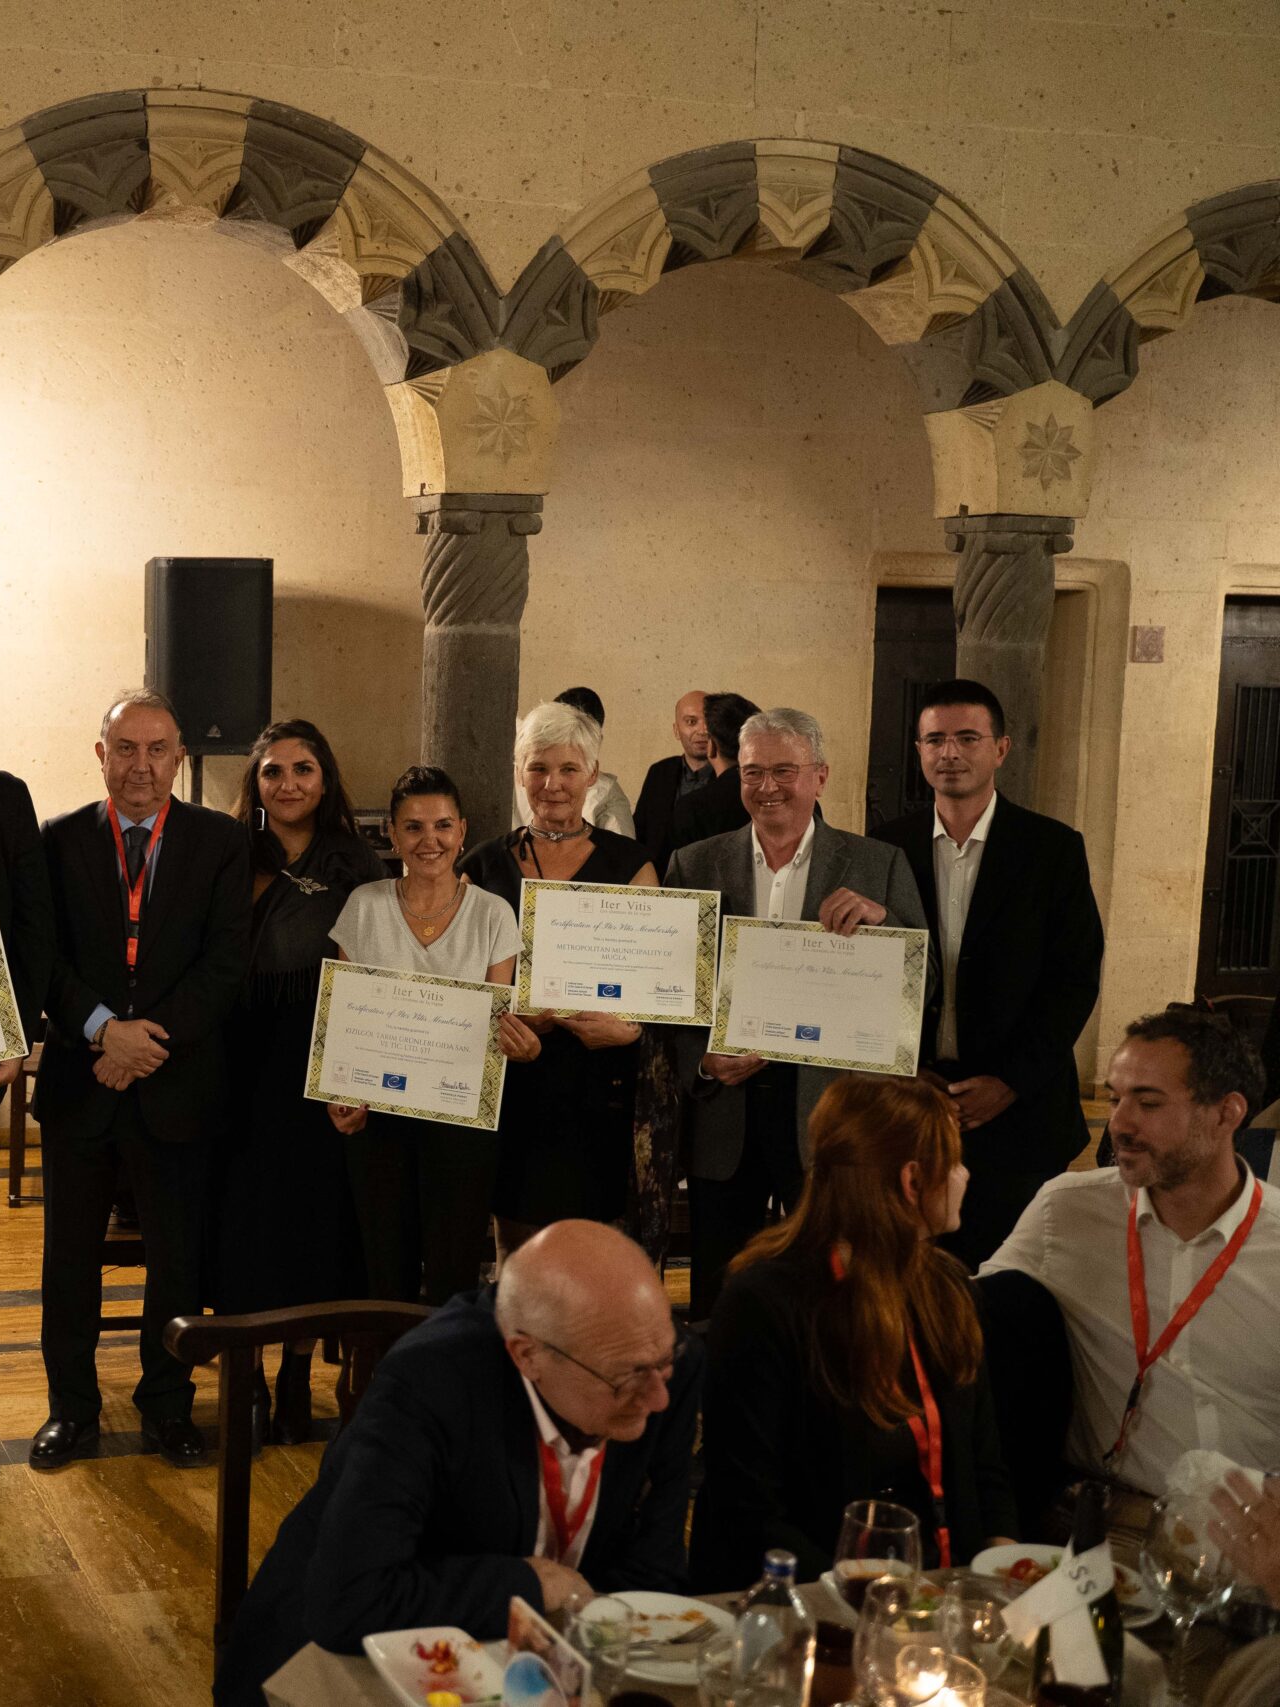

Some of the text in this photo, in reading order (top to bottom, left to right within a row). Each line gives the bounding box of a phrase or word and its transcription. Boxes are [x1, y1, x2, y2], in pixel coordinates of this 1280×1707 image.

[601, 899, 652, 911] Iter Vitis
[550, 919, 591, 929] Certification
[593, 922, 601, 931] of
[637, 925, 679, 936] Membership
[557, 944, 610, 953] METROPOLITAN
[612, 947, 662, 956] MUNICIPALITY
[803, 937, 855, 950] Iter Vitis
[393, 986, 445, 1002] Iter Vitis
[347, 1002, 384, 1014] Certification
[386, 1009, 394, 1018] of
[432, 1016, 473, 1030] Membership
